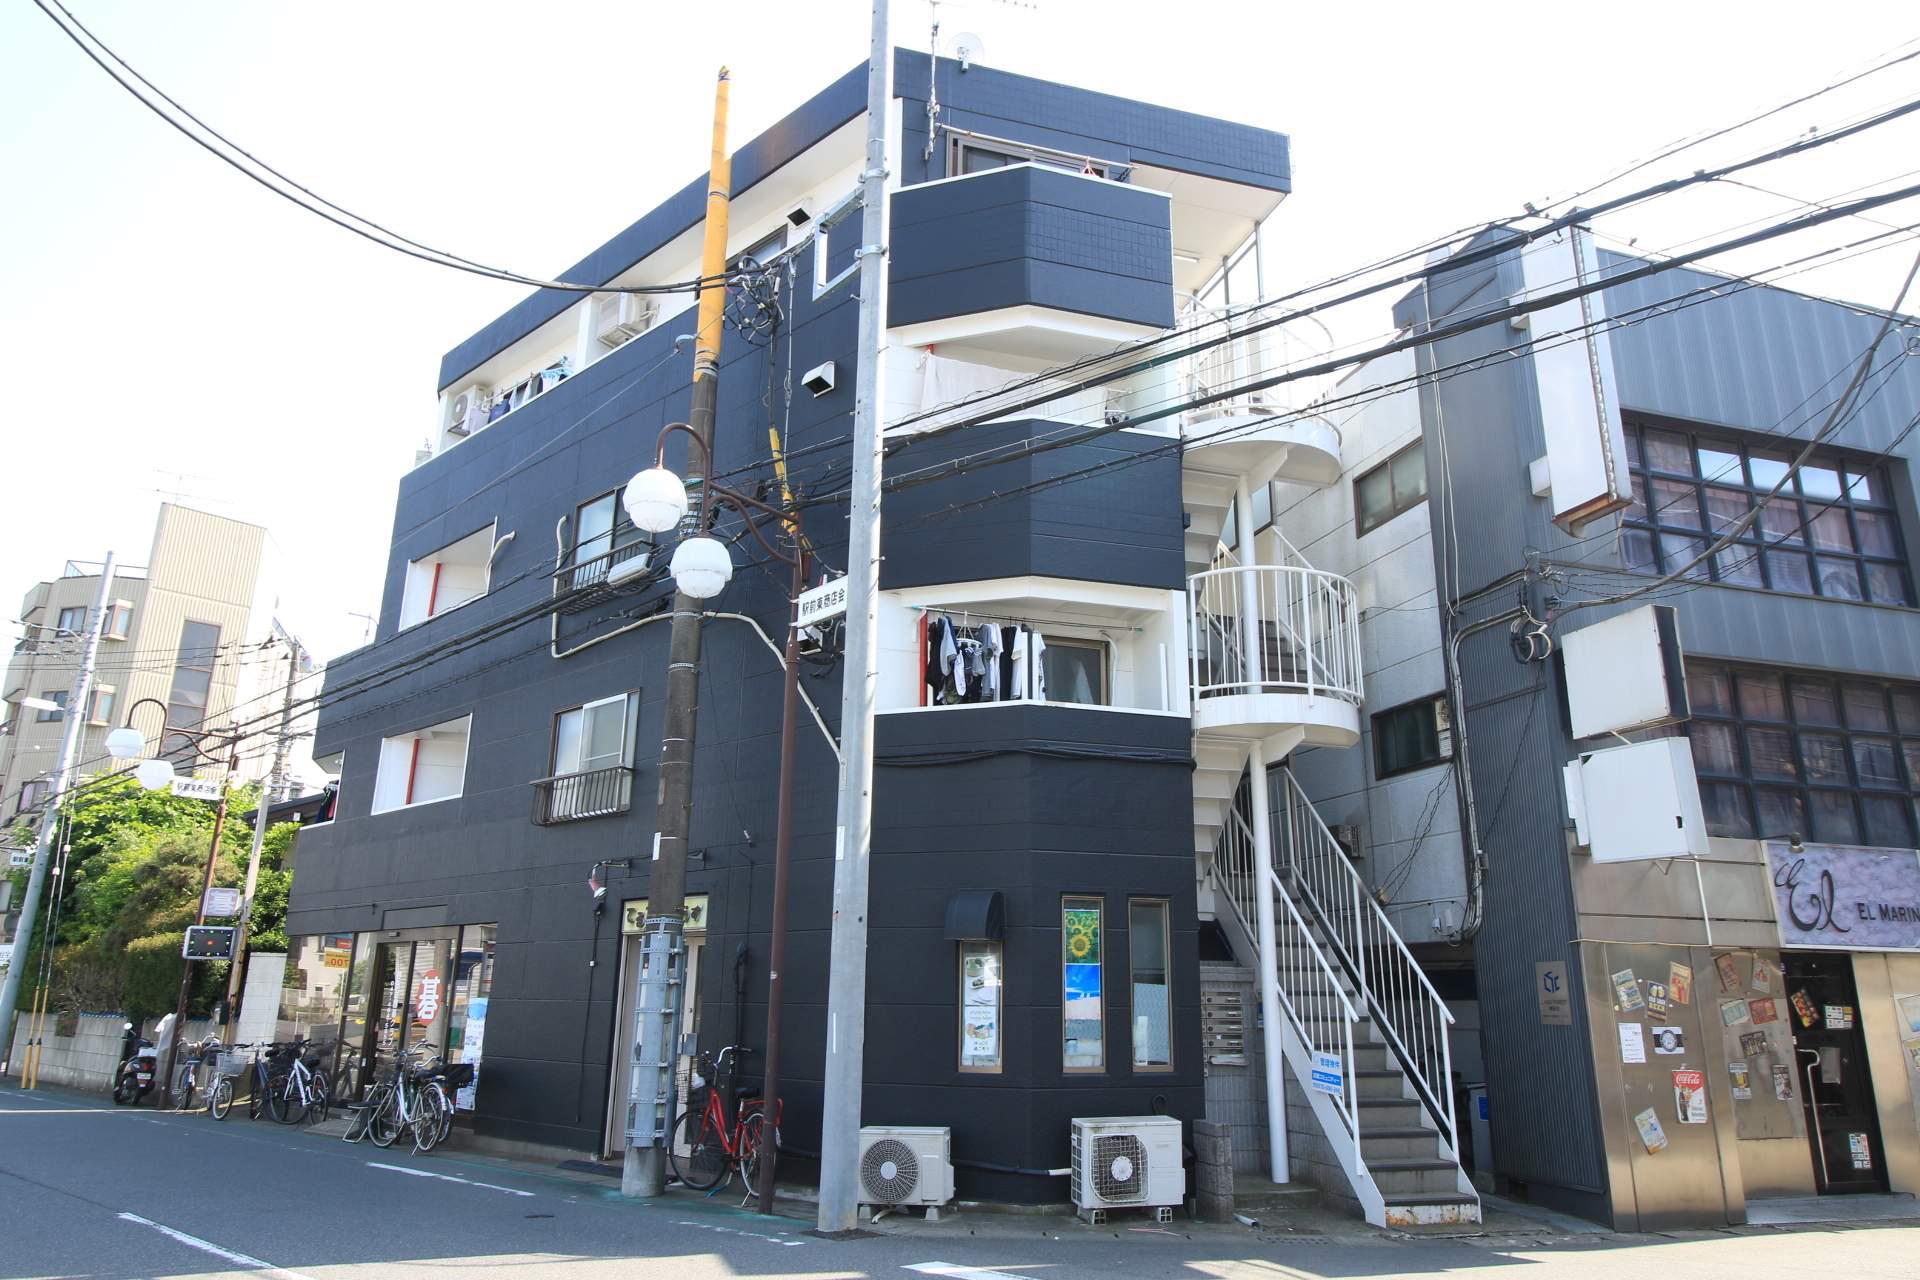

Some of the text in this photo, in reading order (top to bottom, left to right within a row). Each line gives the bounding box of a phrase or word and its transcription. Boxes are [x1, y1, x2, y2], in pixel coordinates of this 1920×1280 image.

[802, 588, 845, 616] 駅前東商店会
[1857, 902, 1876, 921] EL
